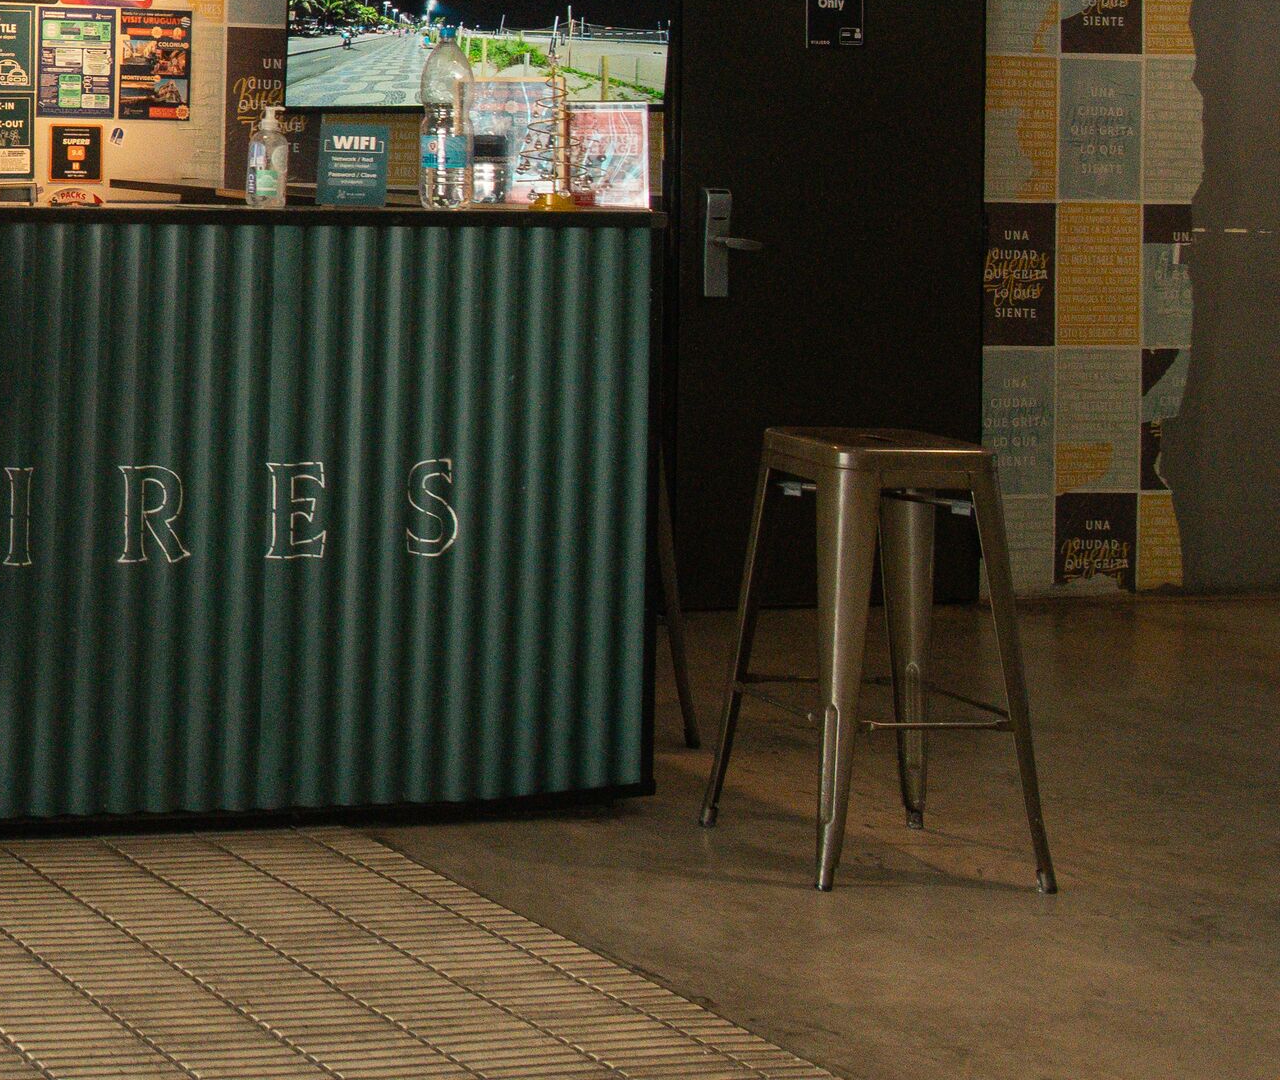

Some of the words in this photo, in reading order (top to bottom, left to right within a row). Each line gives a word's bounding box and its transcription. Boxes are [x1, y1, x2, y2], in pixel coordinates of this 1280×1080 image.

[121, 15, 142, 23] VISIT
[143, 16, 183, 25] URUGUAY
[1083, 16, 1125, 27] SIENTE
[332, 135, 377, 151] WIFI
[60, 191, 87, 200] PACKS
[1004, 230, 1030, 241] UNA
[991, 250, 1036, 260] CIUDAD
[994, 307, 1038, 319] SIENTE
[1085, 520, 1111, 531] UNA
[1072, 539, 1119, 551] CIUDAD
